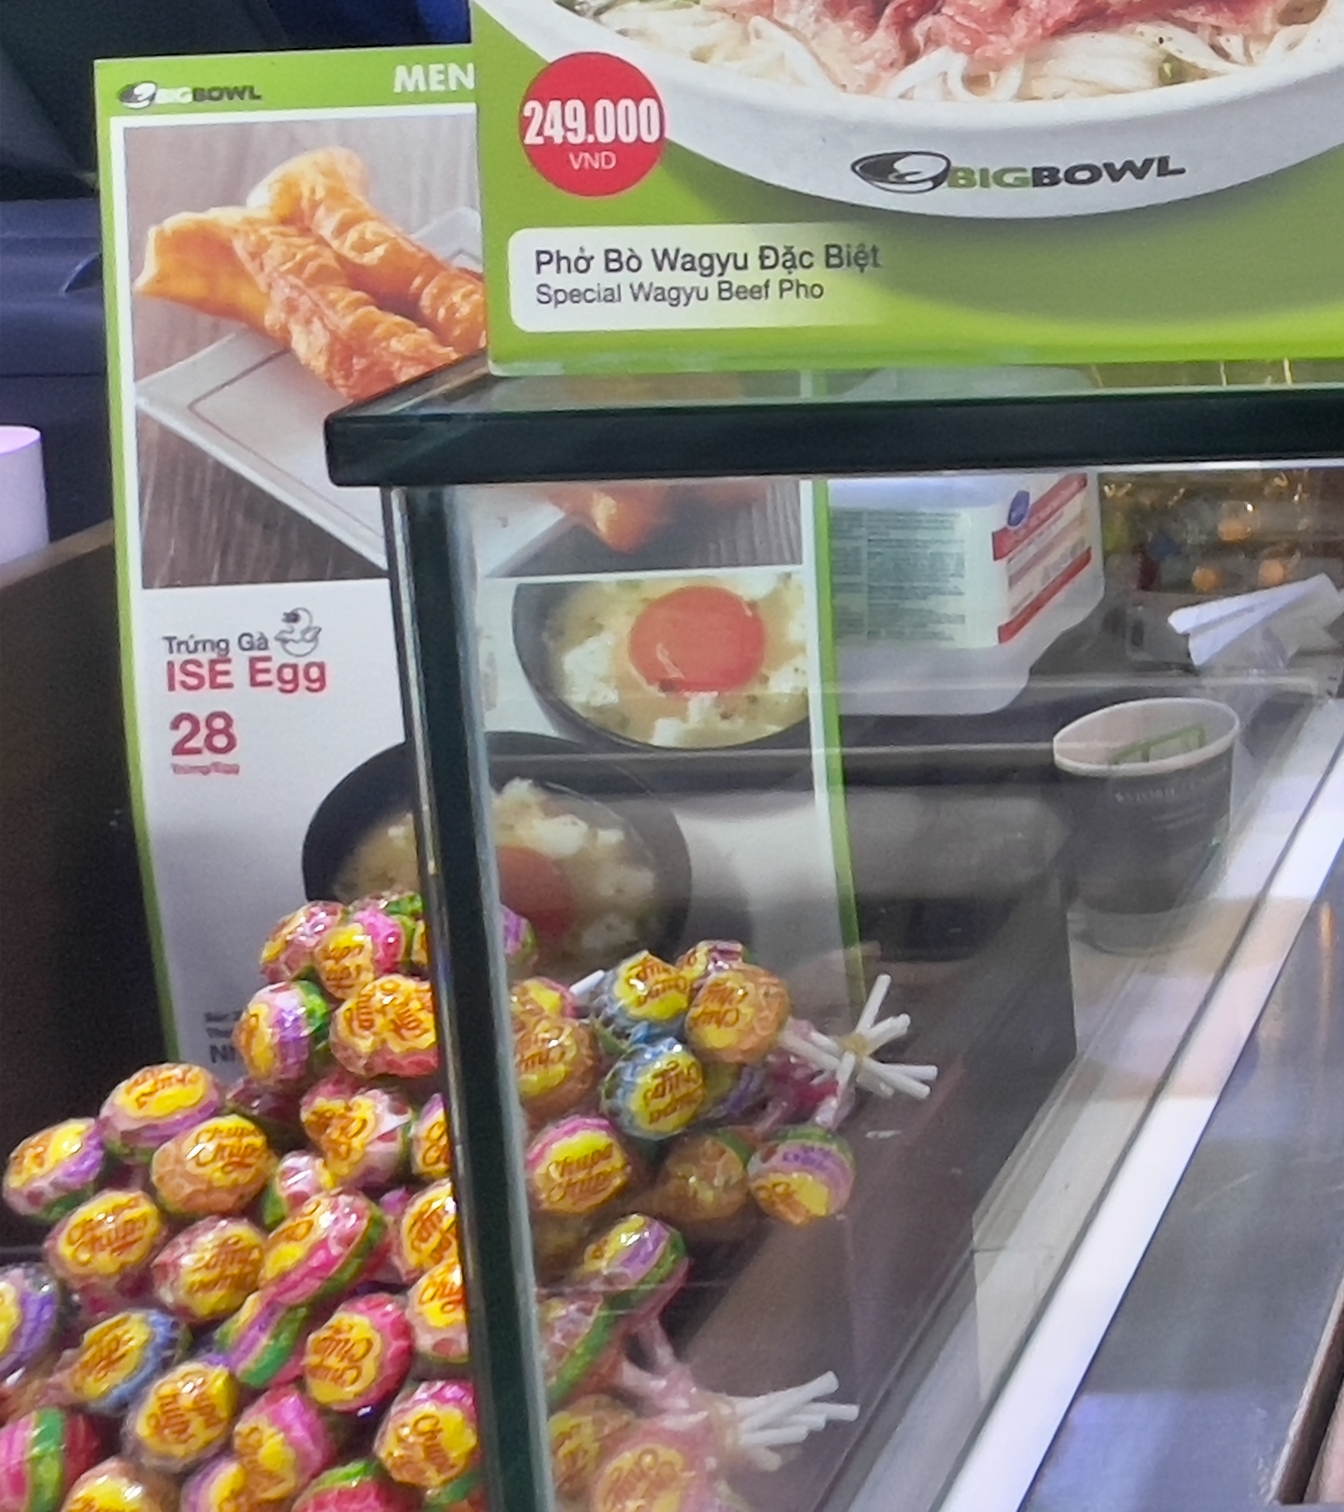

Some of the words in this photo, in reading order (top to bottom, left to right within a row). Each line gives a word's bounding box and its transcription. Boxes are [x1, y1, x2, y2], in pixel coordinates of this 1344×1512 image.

[522, 98, 662, 146] 249.000
[569, 151, 616, 170] VND
[948, 155, 1186, 190] BIGBOWL
[535, 246, 594, 275] Phở
[603, 248, 642, 273] Bò
[652, 247, 748, 278] Wagyu
[759, 245, 814, 275] Đặc
[825, 243, 881, 275] Biệt
[536, 283, 622, 309] Special
[630, 282, 709, 307] Wagyu
[718, 279, 770, 302] Beef
[779, 278, 824, 300] Pho
[162, 634, 229, 658] Trứng
[237, 632, 269, 651] Gà
[167, 658, 234, 692] ISE
[249, 656, 326, 694] Egg
[170, 711, 237, 755] 28
